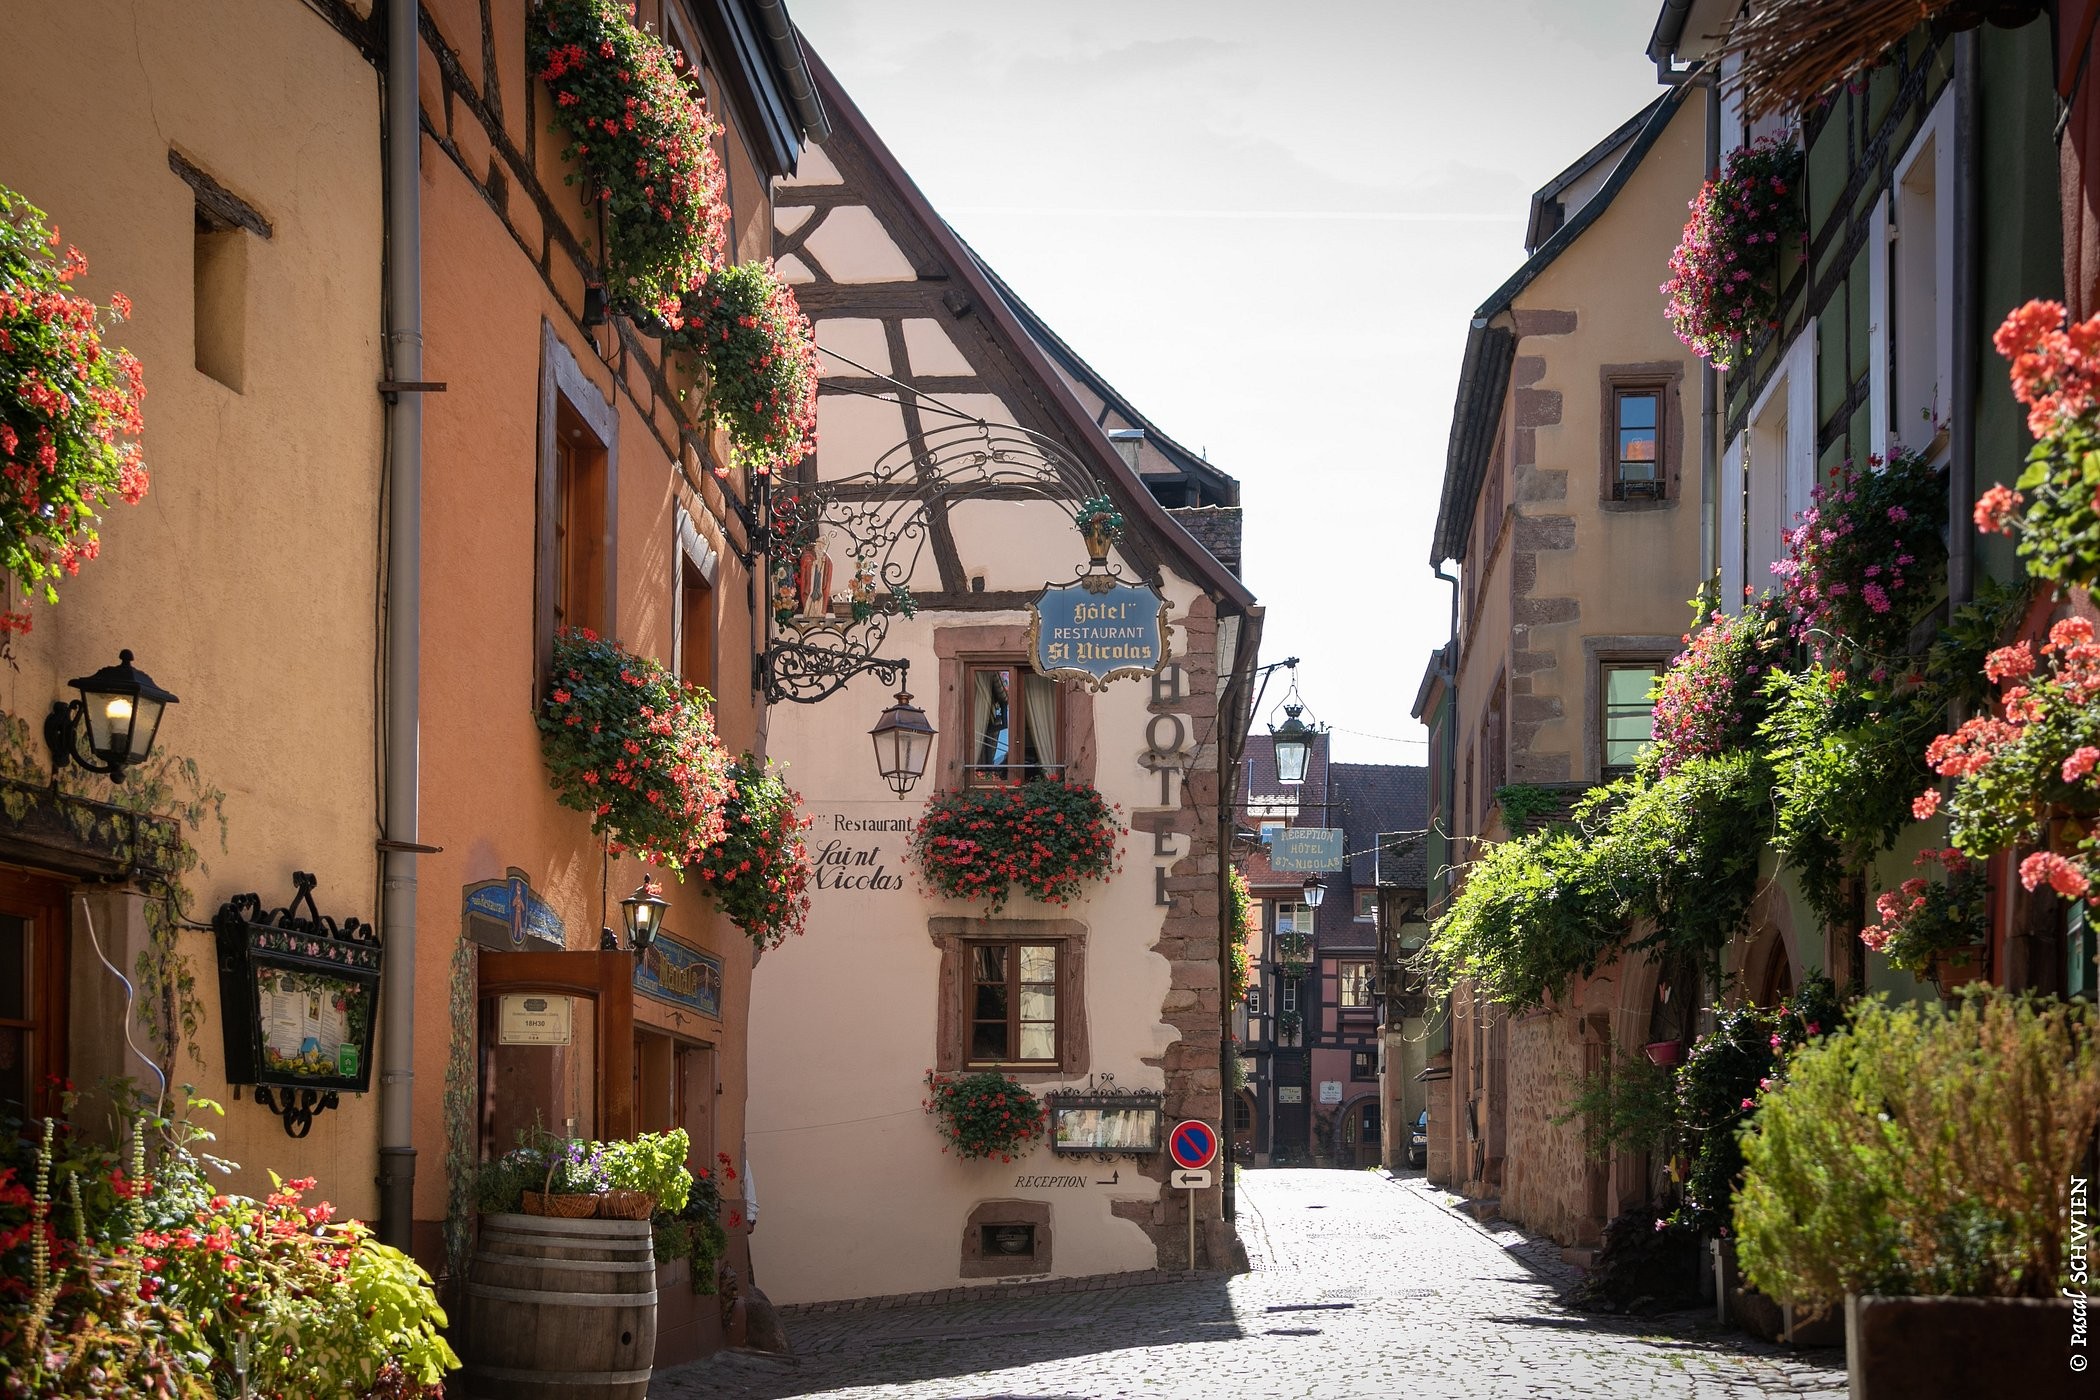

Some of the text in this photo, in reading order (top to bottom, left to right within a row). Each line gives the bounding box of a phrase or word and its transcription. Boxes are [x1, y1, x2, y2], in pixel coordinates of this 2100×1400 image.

[1054, 627, 1145, 639] RESTAURANT
[1048, 642, 1152, 664] St Nicolas
[1146, 662, 1186, 908] HOTEL
[834, 814, 912, 832] Restaurant
[1281, 829, 1334, 843] RECEPTION
[811, 839, 881, 866] Saint
[1291, 842, 1324, 854] HÔTEL
[805, 865, 904, 890] Nicolas
[1014, 1175, 1088, 1189] RECEPTION
